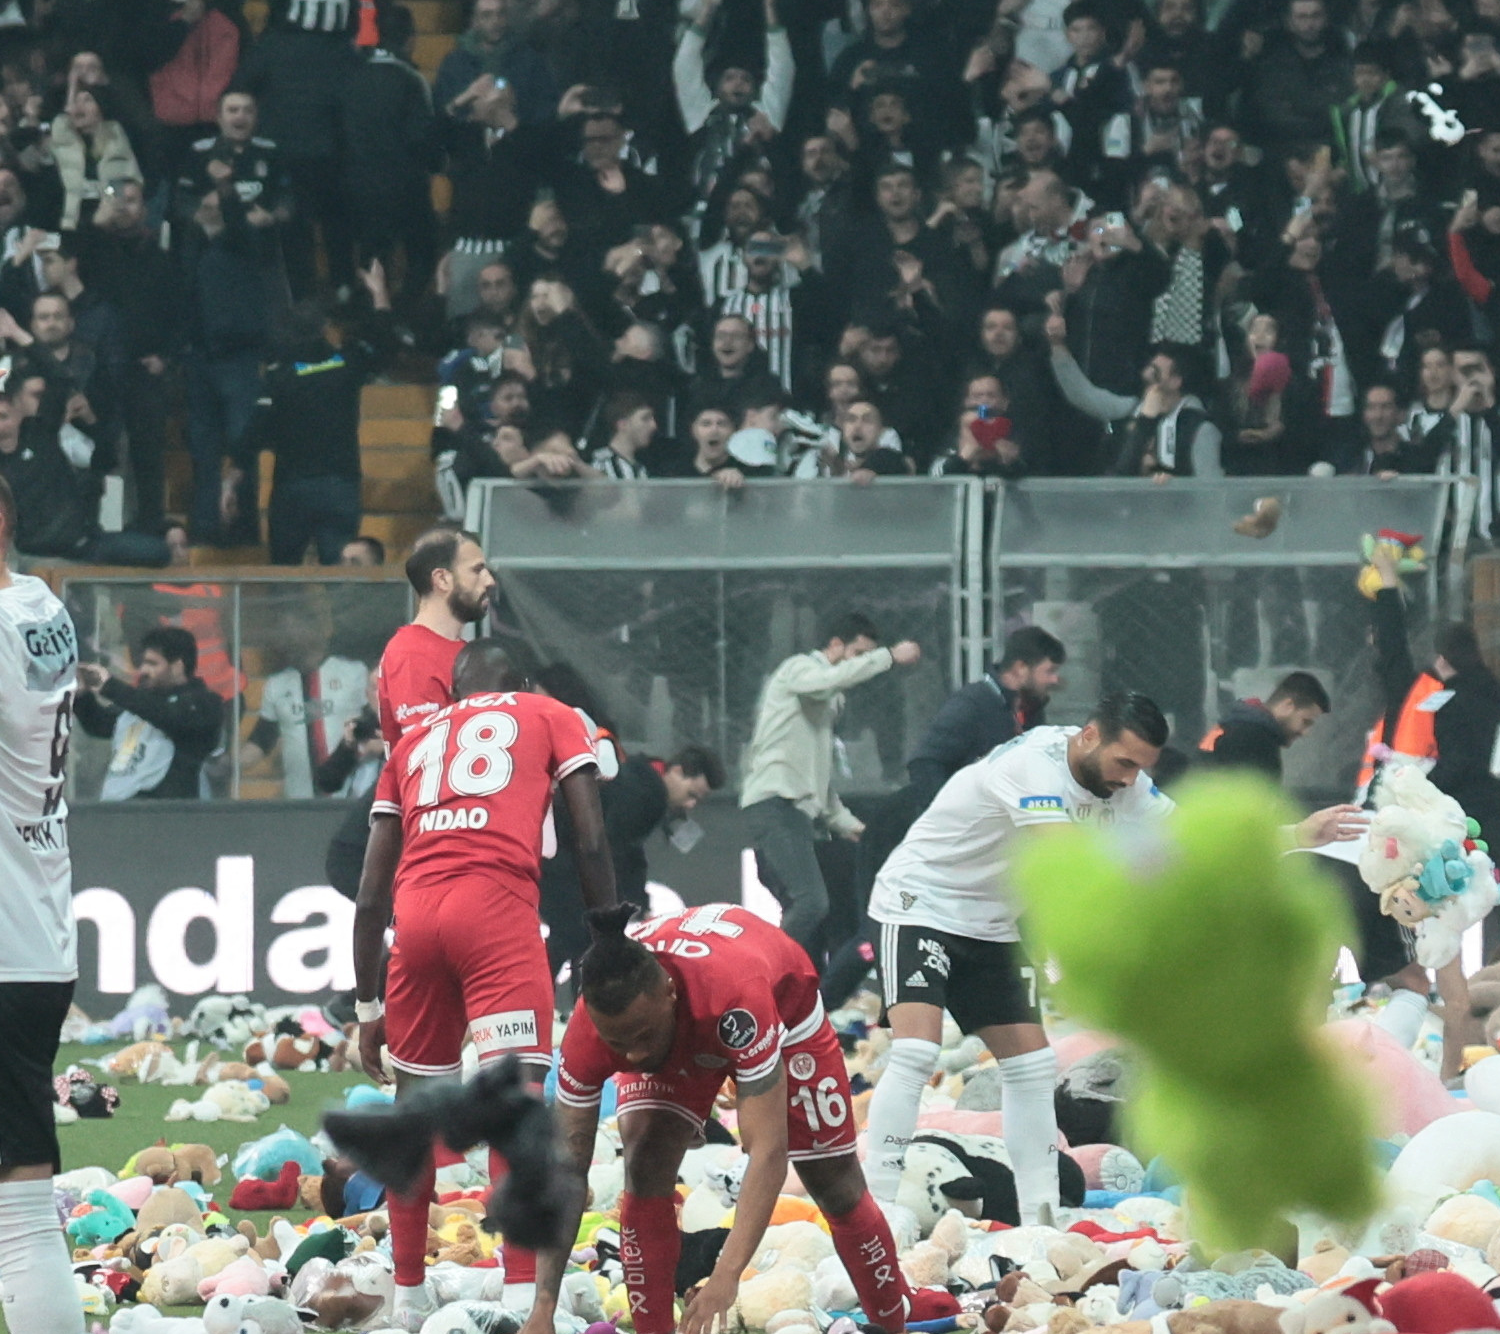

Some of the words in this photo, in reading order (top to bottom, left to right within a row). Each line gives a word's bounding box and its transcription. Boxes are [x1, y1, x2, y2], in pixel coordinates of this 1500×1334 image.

[408, 711, 518, 806] 18
[419, 807, 489, 834] NDAO
[496, 1021, 535, 1037] YAPIM
[791, 1076, 847, 1132] 16
